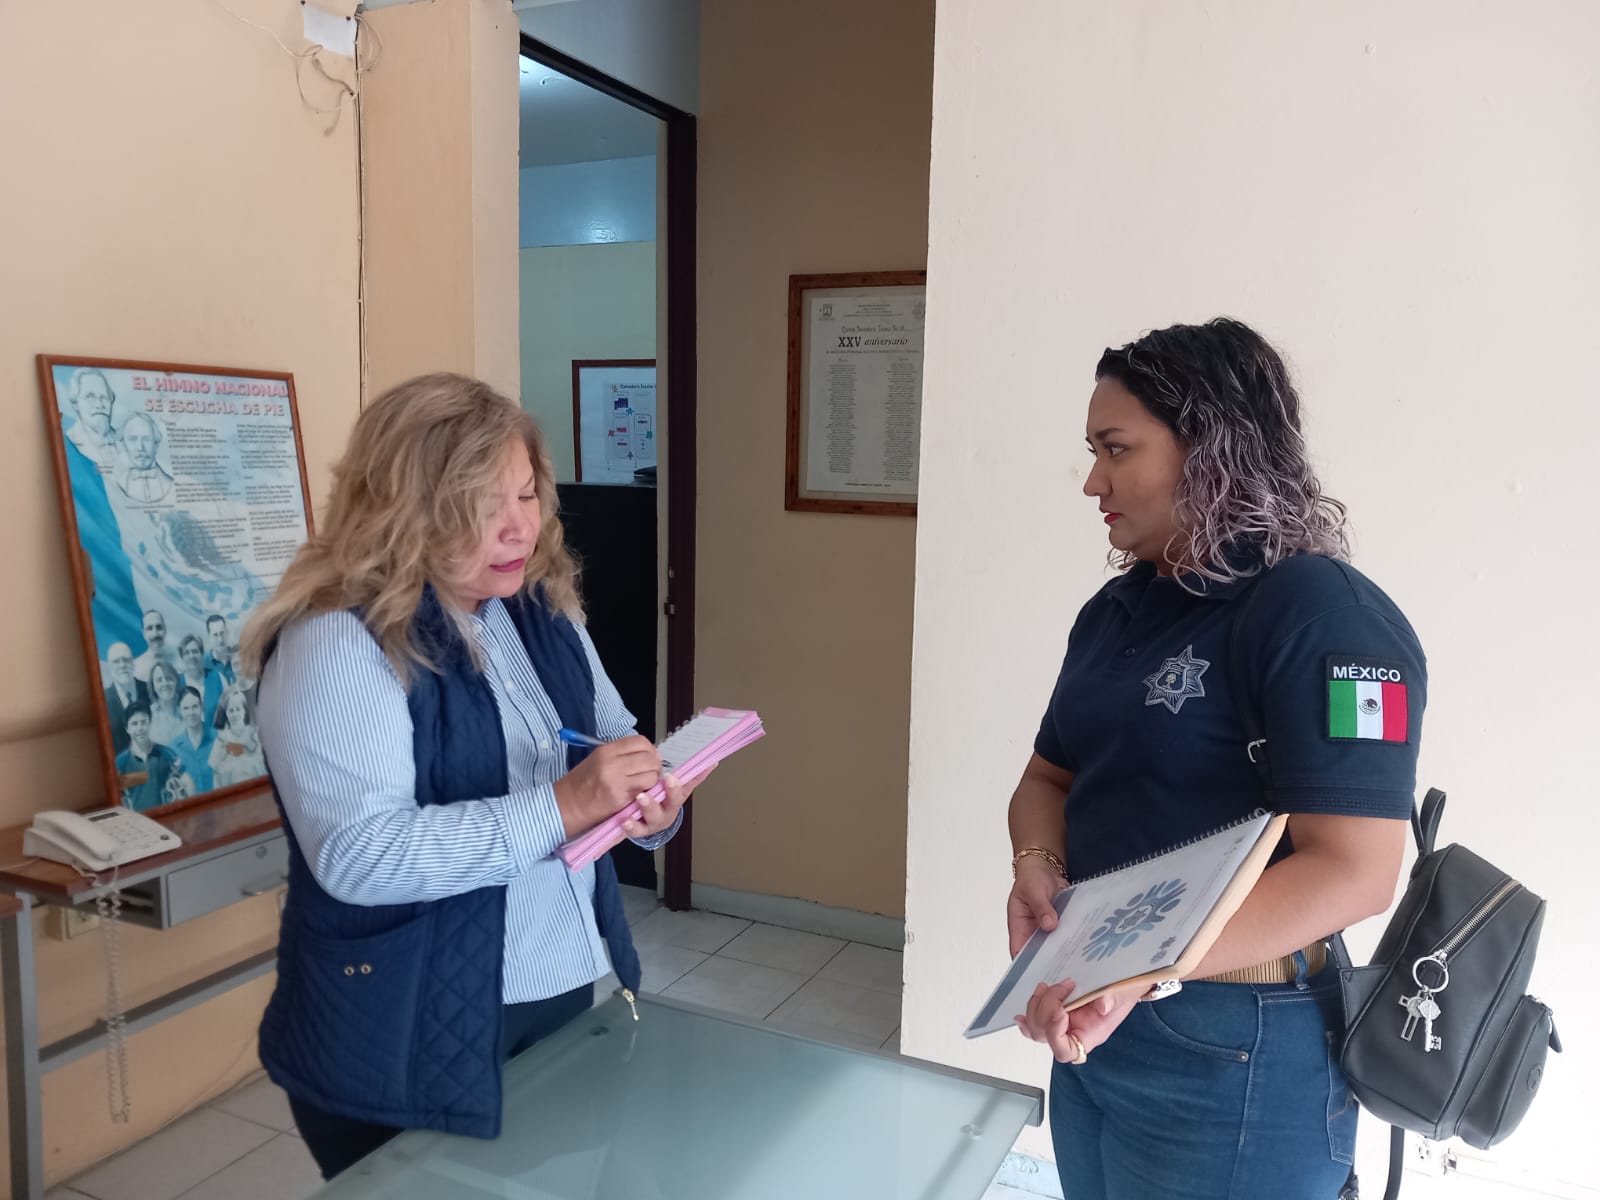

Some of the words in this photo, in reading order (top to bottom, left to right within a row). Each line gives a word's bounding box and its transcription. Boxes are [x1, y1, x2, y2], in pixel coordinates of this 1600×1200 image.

[838, 336, 861, 348] XXV
[864, 336, 908, 346] aniversario
[132, 376, 152, 391] EL
[155, 377, 211, 394] HIMNO
[214, 381, 288, 398] NACIONAL
[145, 398, 164, 412] SE
[168, 400, 238, 415] ESCUCHA
[241, 403, 260, 416] DE
[263, 404, 285, 416] PIE
[1333, 663, 1401, 682] MÉXICO
